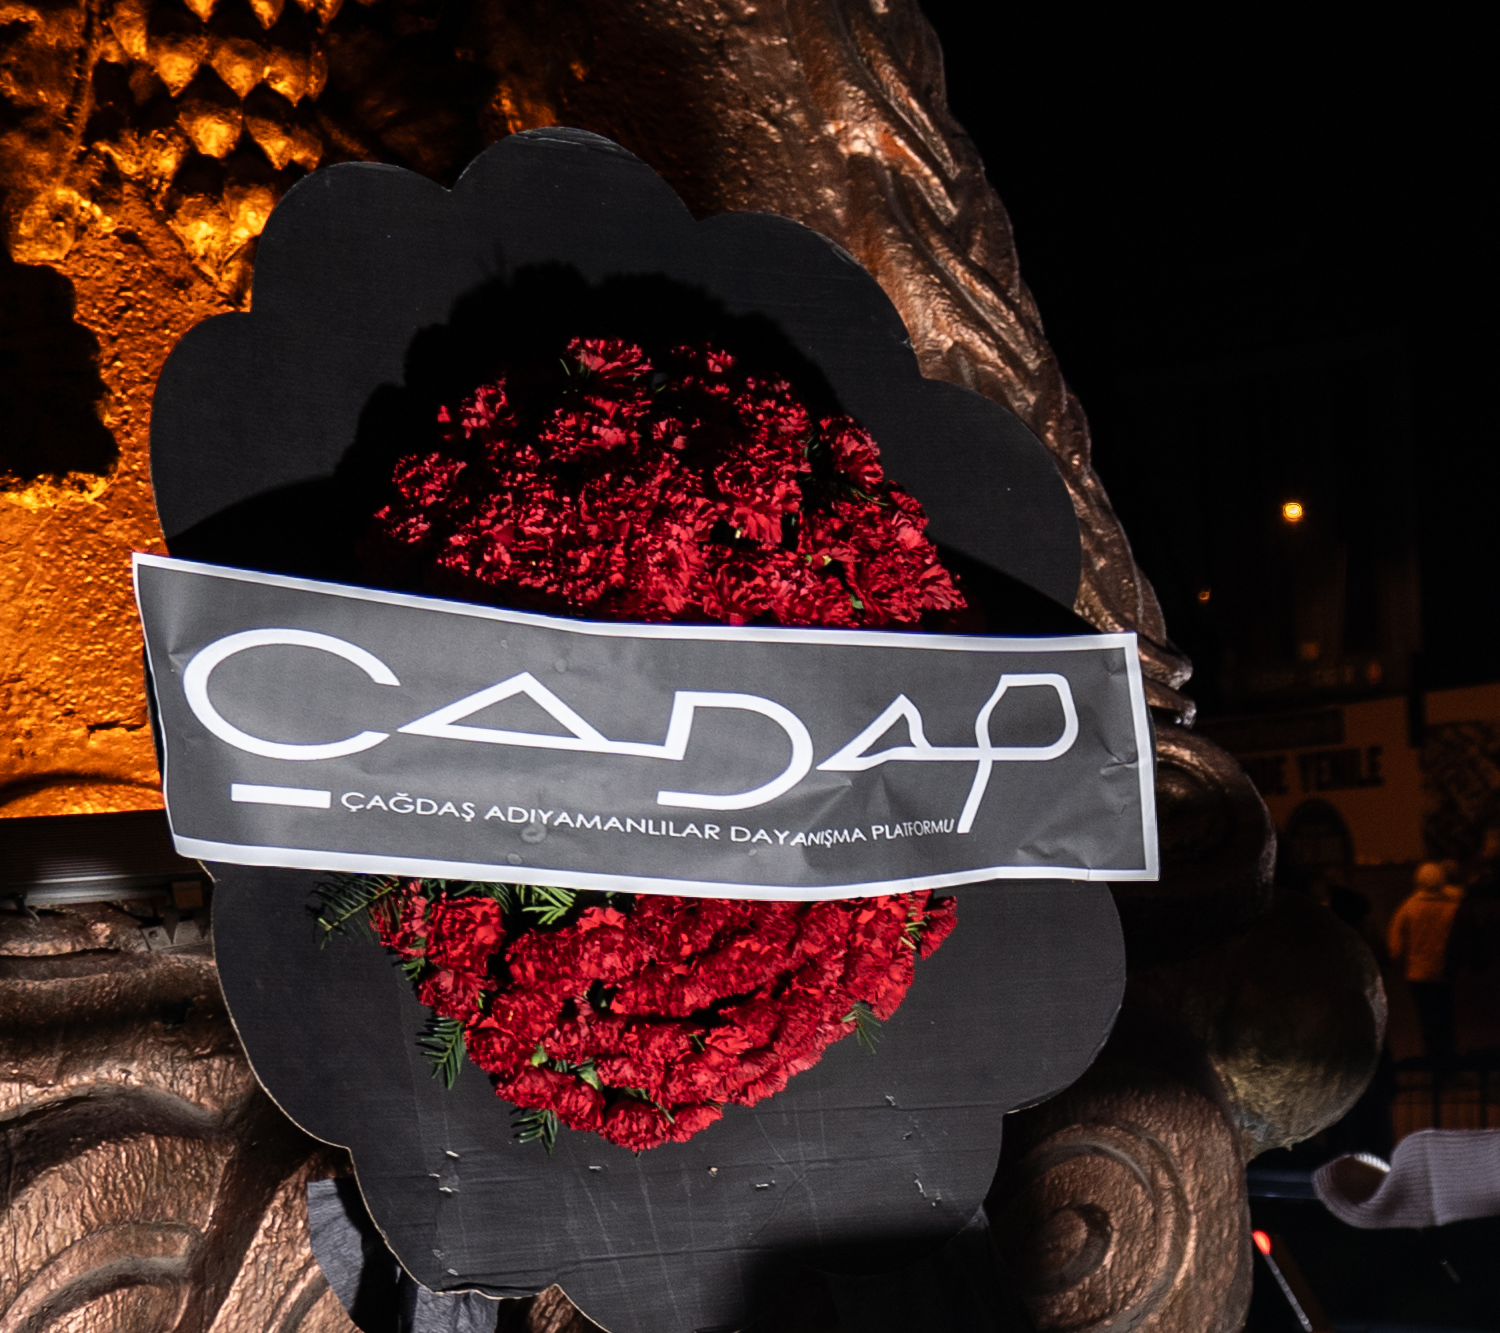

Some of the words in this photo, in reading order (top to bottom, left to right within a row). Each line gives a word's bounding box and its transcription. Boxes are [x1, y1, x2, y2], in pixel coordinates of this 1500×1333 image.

[340, 788, 476, 826] ÇAĞDAŞ
[483, 801, 720, 845] ADIYAMANLILAR
[729, 821, 866, 850] DAYANIŞMA
[869, 817, 956, 845] PLATFORMU
